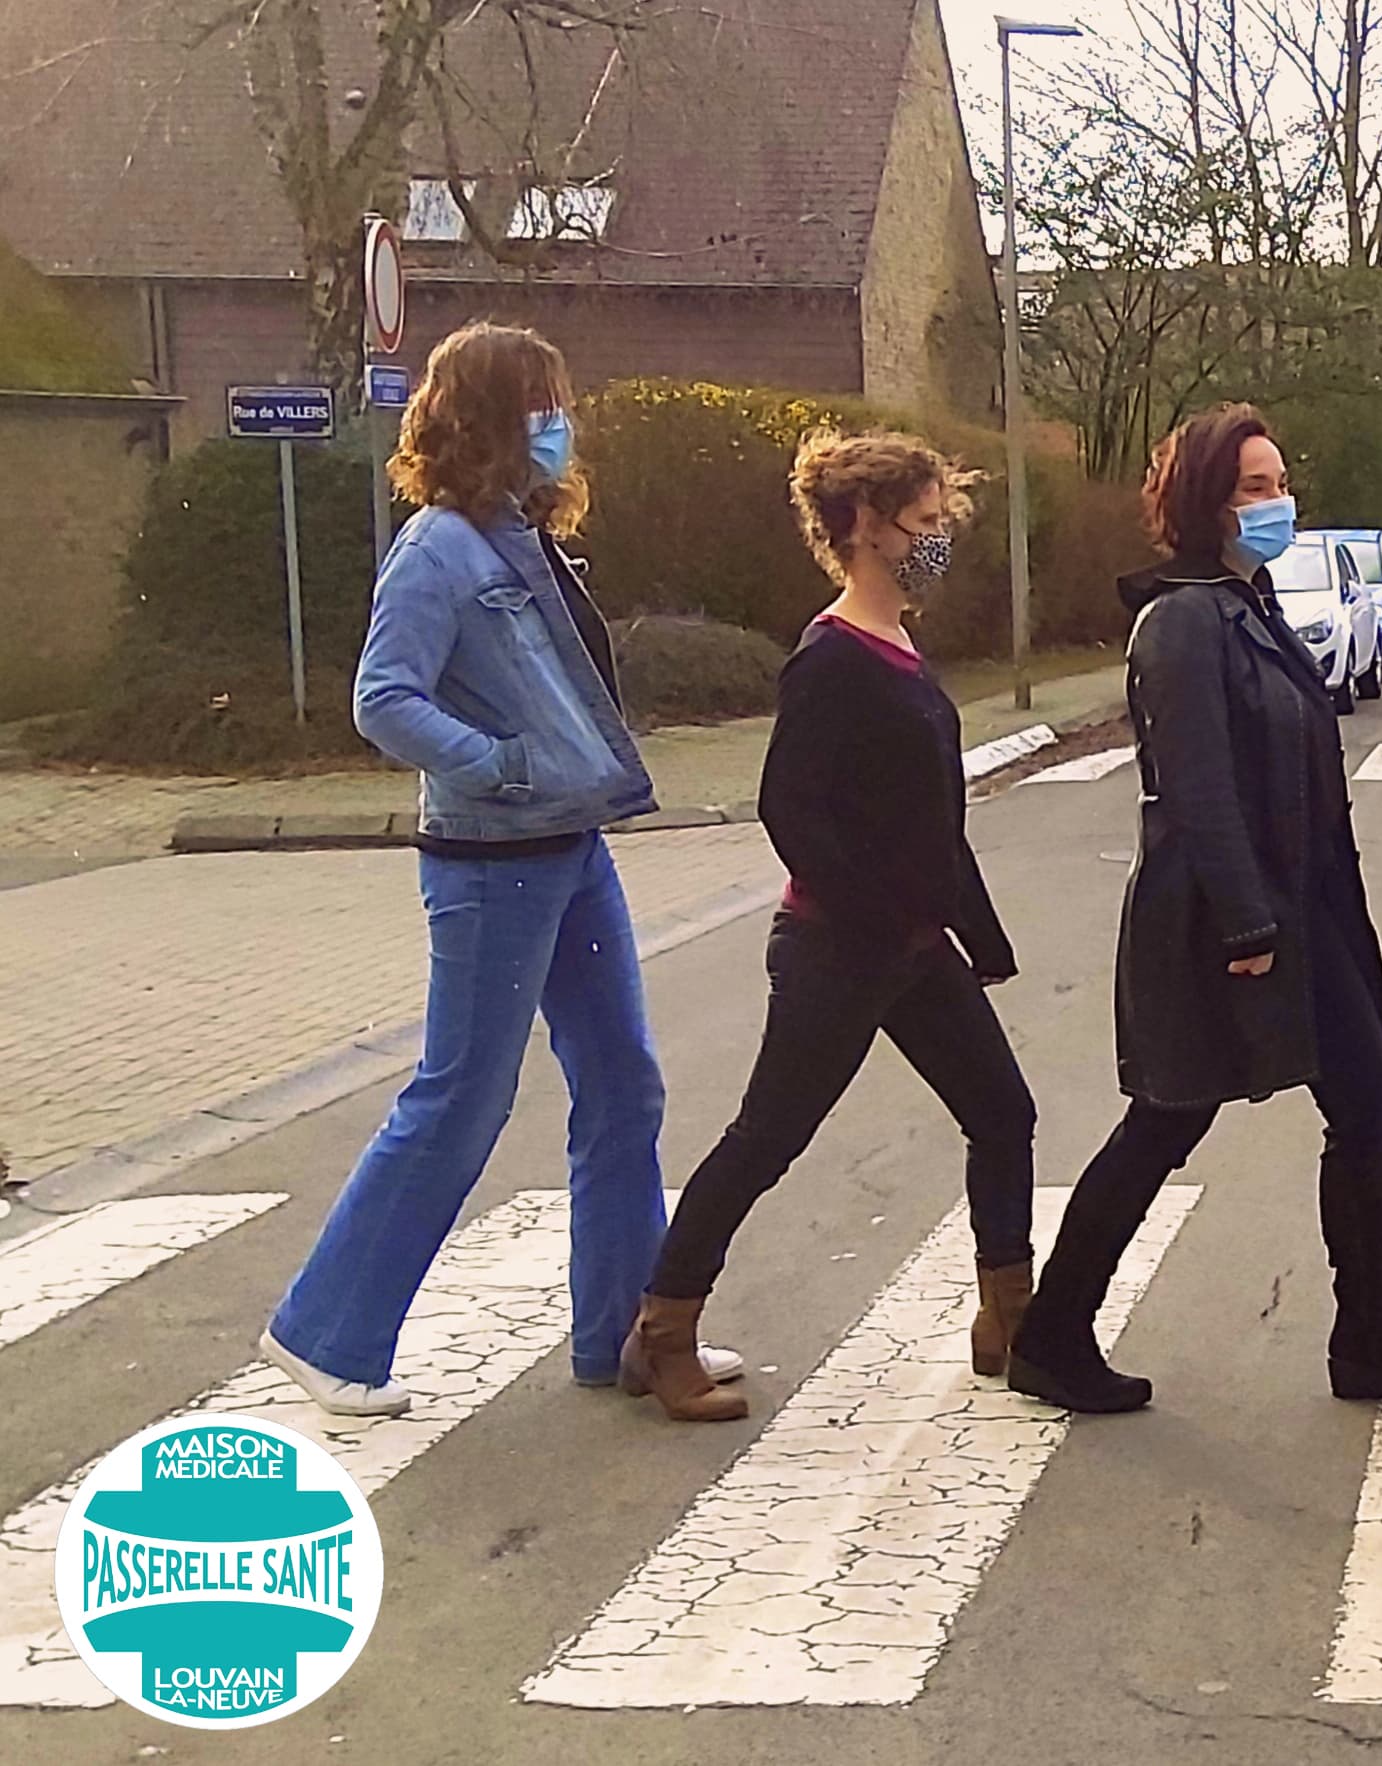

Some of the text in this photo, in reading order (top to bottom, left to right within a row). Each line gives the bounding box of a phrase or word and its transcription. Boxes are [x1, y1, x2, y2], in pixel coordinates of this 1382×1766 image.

[233, 406, 328, 418] Rue de VILLERS
